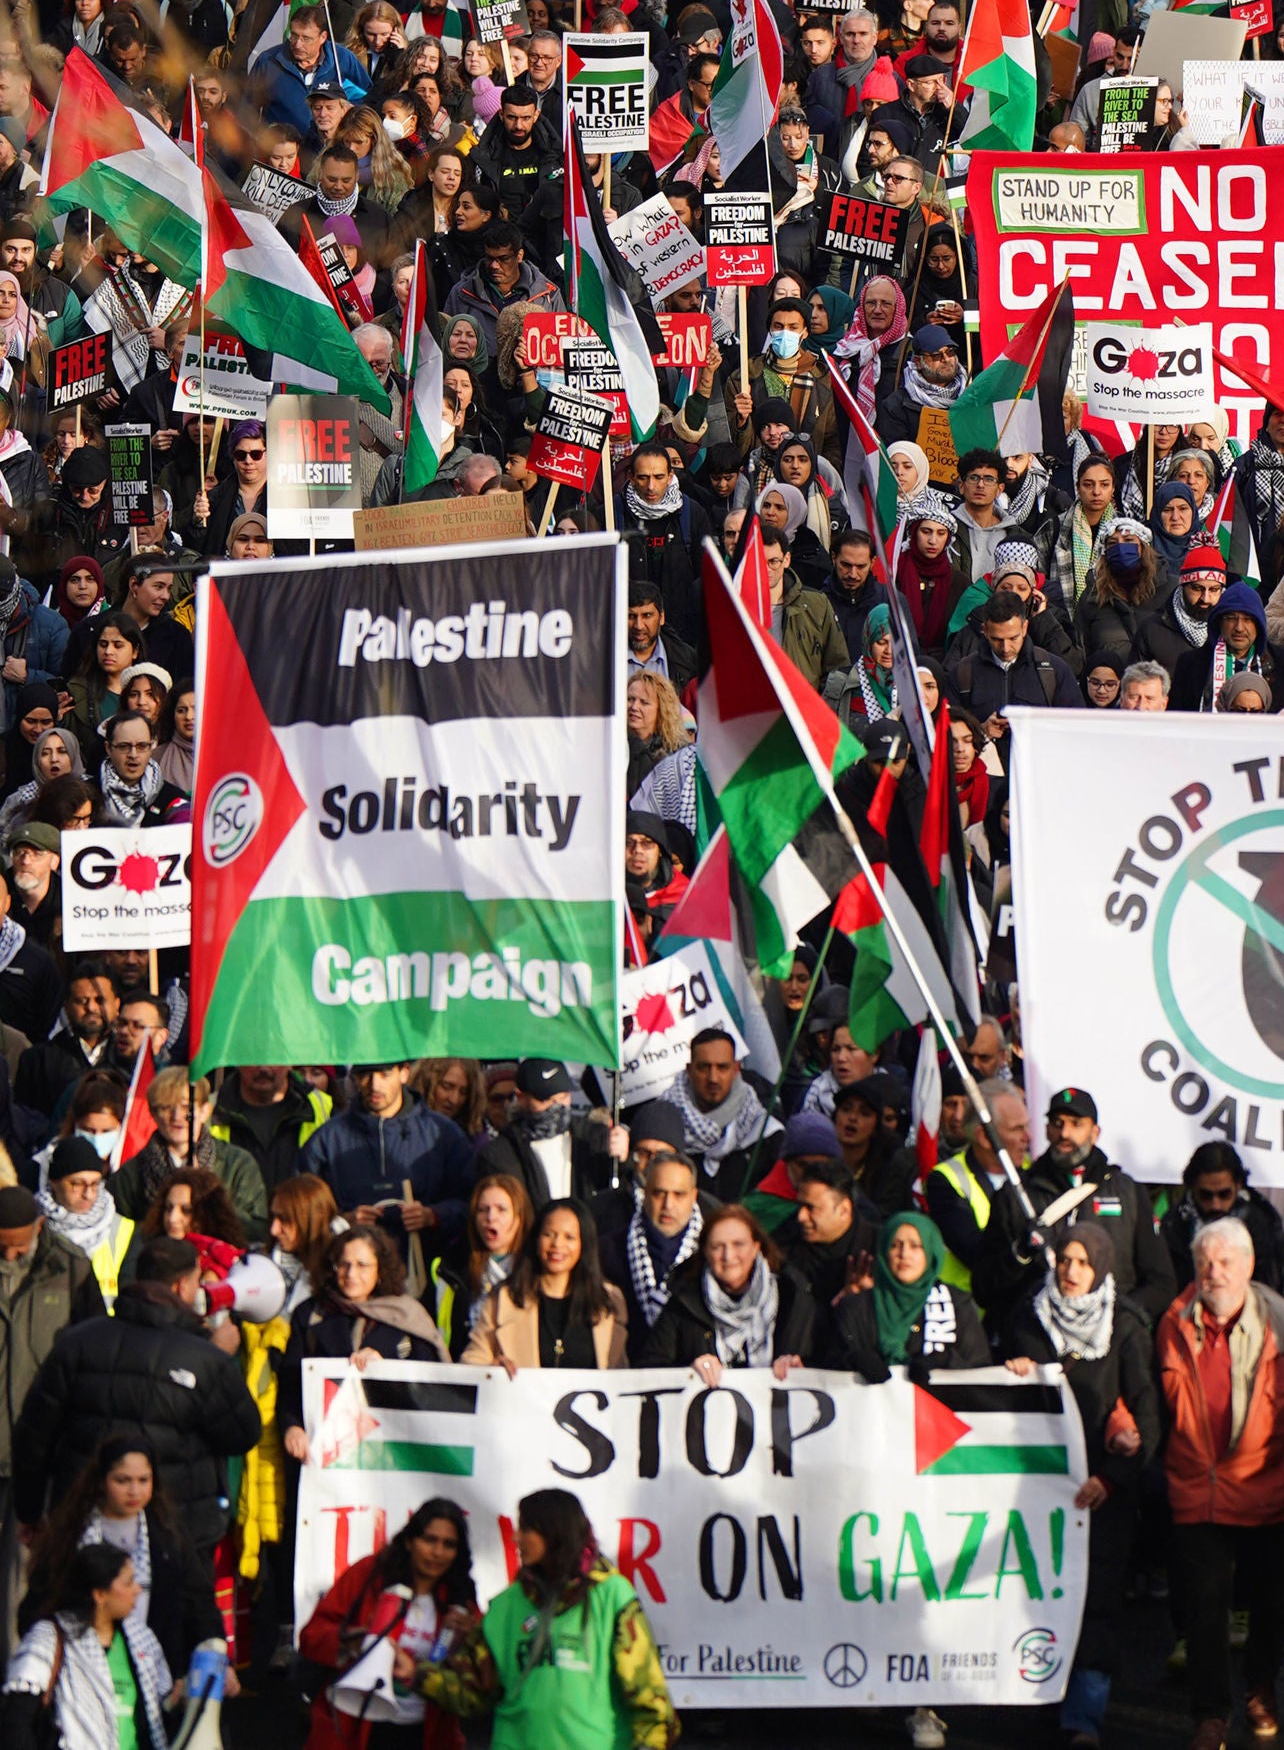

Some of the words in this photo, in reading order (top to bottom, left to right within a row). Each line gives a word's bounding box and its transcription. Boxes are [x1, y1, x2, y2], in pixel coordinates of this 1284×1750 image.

[476, 0, 522, 20] PALESTINE
[567, 84, 644, 115] FREE
[1101, 122, 1148, 136] PALESTINE
[243, 181, 267, 204] KILL
[1003, 177, 1060, 199] STAND
[1068, 180, 1093, 199] UP
[1099, 181, 1136, 200] FOR
[1160, 164, 1267, 233] NO
[711, 206, 766, 223] FREEDOM
[829, 196, 900, 243] FREE
[1021, 202, 1116, 224] HUMANITY
[709, 227, 769, 244] PALESTINE
[825, 229, 895, 261] PALESTINE
[56, 334, 108, 388] FREE
[54, 371, 107, 407] PALESTINE
[557, 384, 582, 398] Socialist
[582, 394, 607, 408] Worker
[569, 371, 625, 392] PALESTIN
[1093, 381, 1119, 399] Stop
[1121, 382, 1142, 399] the
[1144, 385, 1205, 401] massacre
[549, 396, 606, 428] FREEDOM
[279, 419, 352, 463] FREE
[540, 416, 604, 450] PALESTINE
[112, 480, 148, 496] PALESTINE
[278, 462, 353, 486] PALESTINE
[1181, 569, 1227, 584] NGLAN
[338, 601, 573, 668] Palestine
[213, 804, 247, 839] PSC
[317, 777, 580, 852] Solidarity
[1104, 780, 1213, 934] STOP
[74, 904, 110, 921] Stop
[115, 904, 140, 919] the
[144, 905, 192, 919] mass
[312, 943, 592, 1018] Campaign
[671, 970, 714, 1019] za
[603, 1058, 641, 1083] Sop
[644, 1046, 670, 1067] the
[551, 1386, 836, 1479] STOP
[700, 1512, 804, 1604] ON
[838, 1505, 1066, 1604] GAZA!
[657, 1645, 687, 1674] For
[699, 1642, 802, 1674] Palestine
[886, 1653, 930, 1683] FOA
[941, 1651, 998, 1669] FRIENDS
